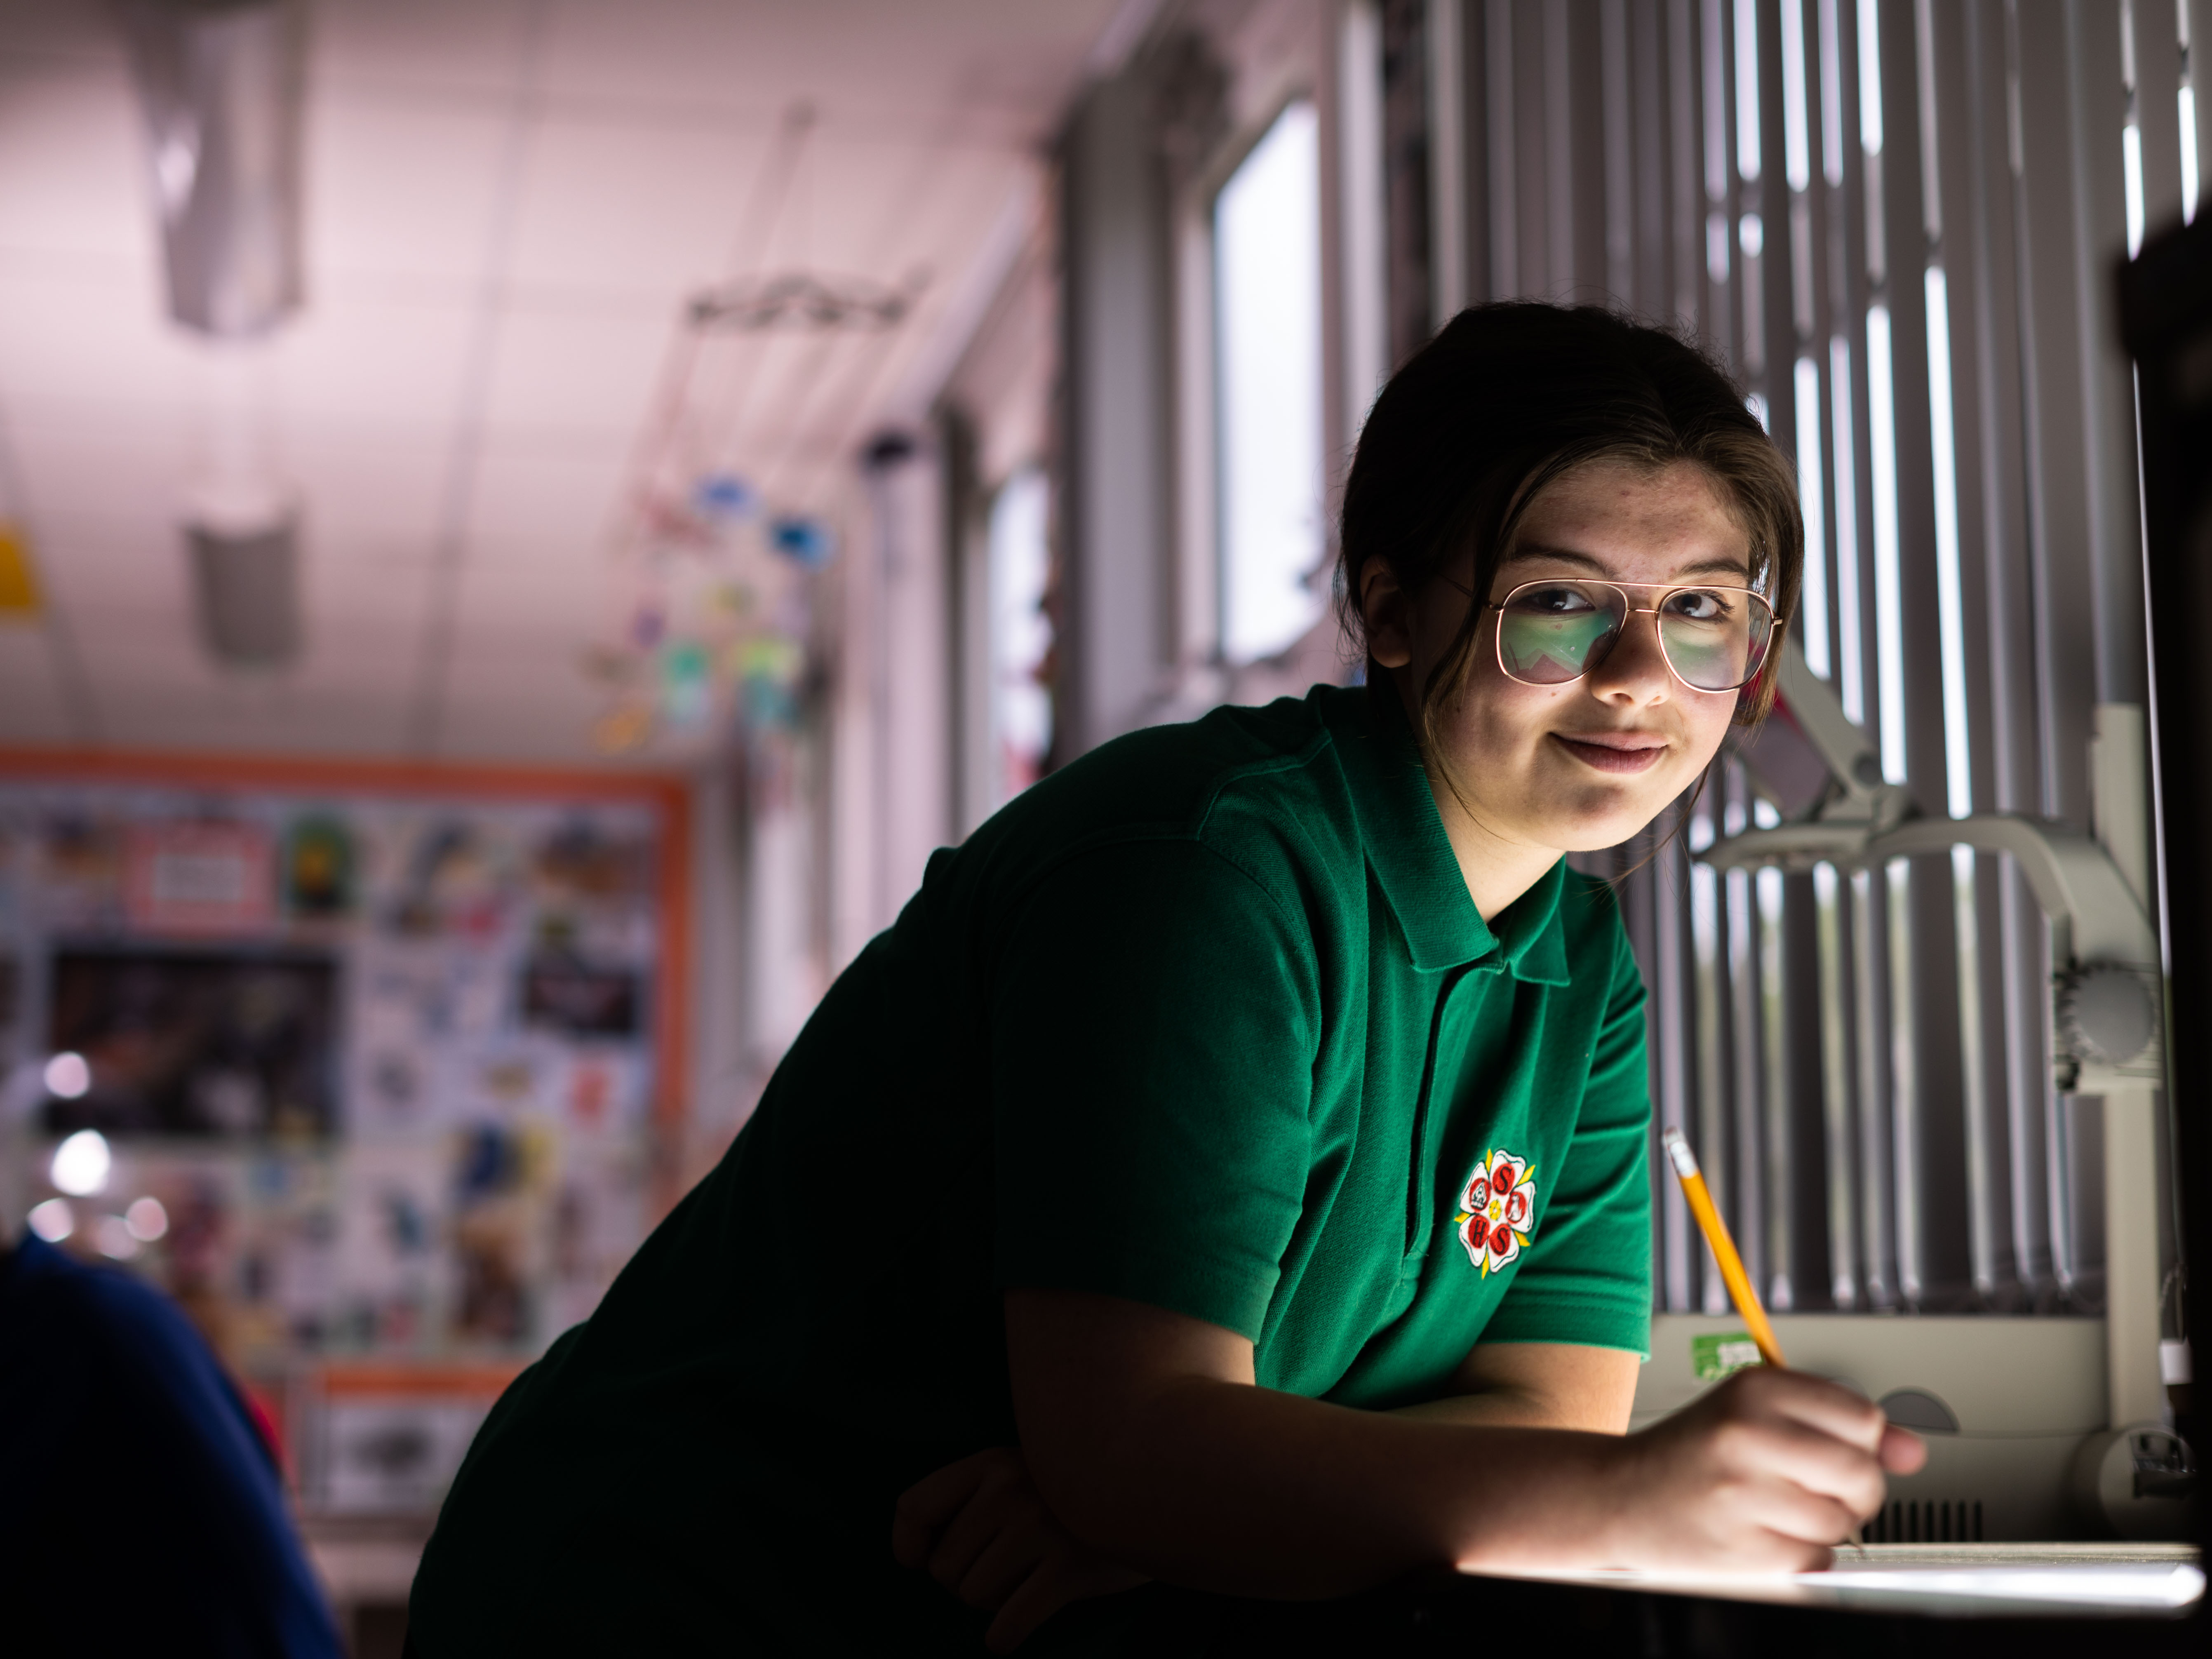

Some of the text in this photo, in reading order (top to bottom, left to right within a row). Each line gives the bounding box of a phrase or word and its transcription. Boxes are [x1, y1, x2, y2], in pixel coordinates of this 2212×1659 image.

[1495, 1166, 1512, 1193] S
[1472, 1220, 1486, 1247] H
[1494, 1227, 1509, 1255] S
